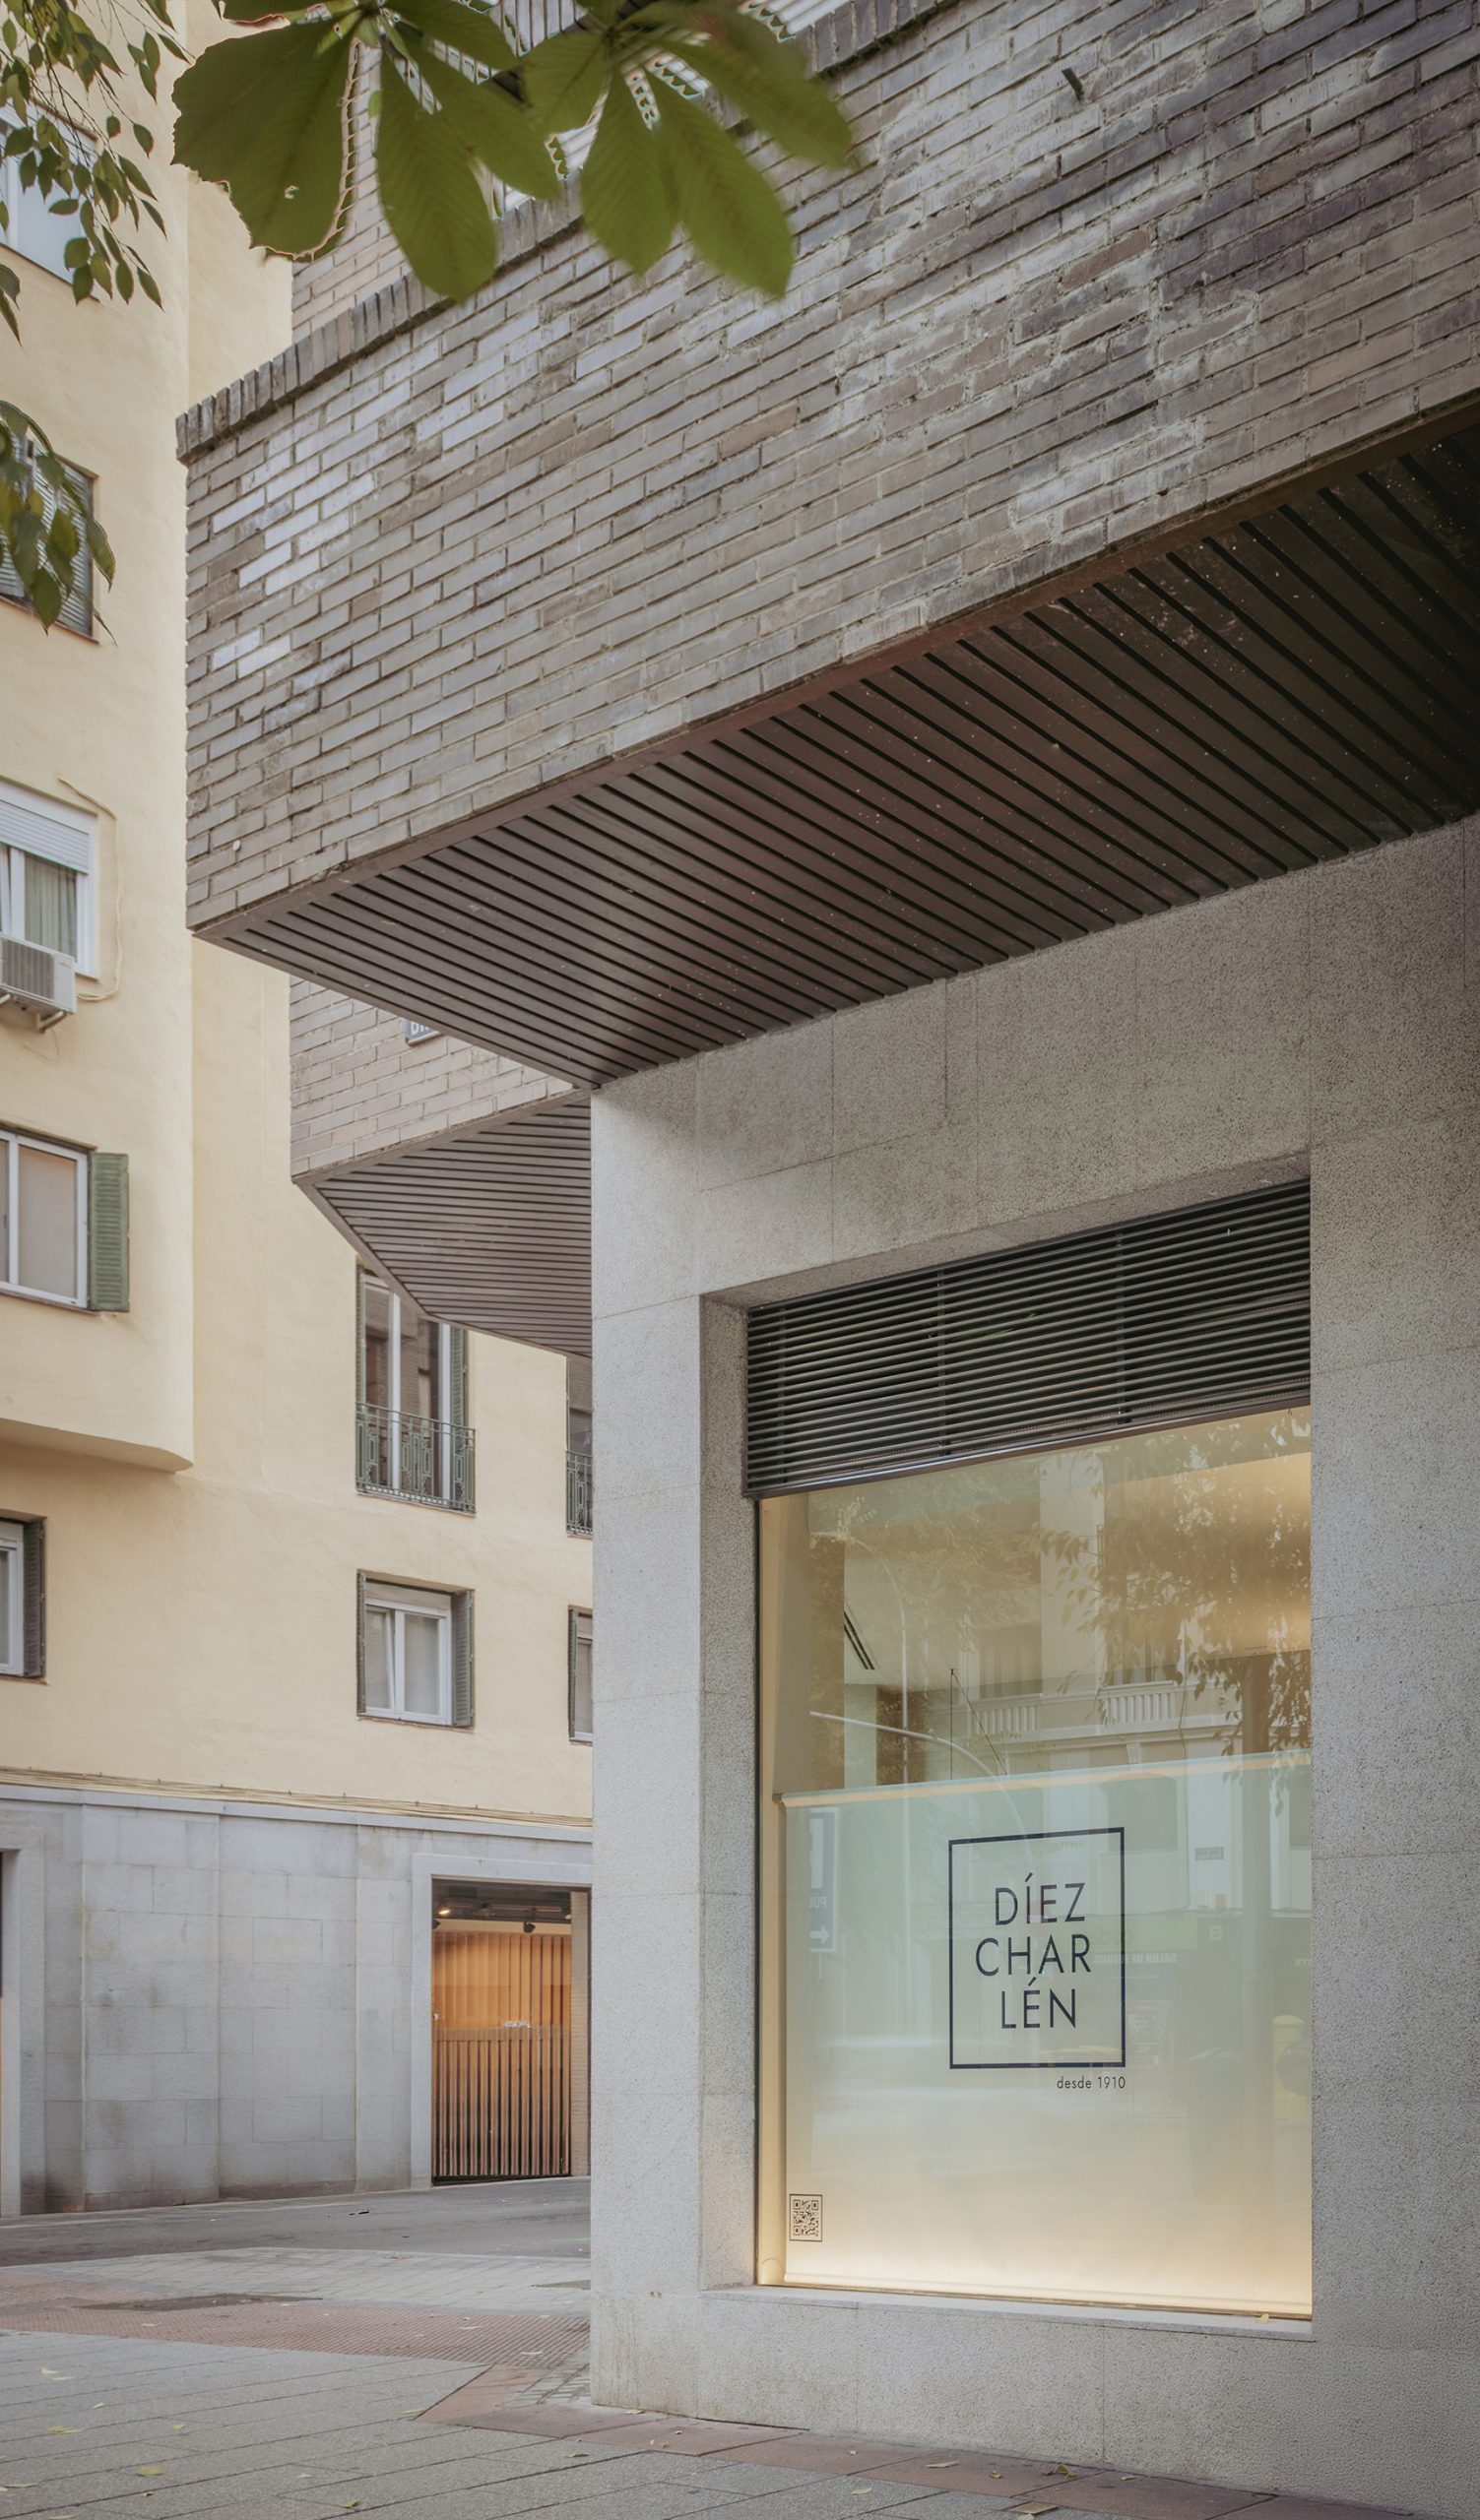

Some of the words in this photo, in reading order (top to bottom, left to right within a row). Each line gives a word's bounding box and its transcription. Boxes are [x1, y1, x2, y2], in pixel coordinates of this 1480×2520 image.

[995, 1871, 1086, 1926] DÍEZ
[975, 1933, 1092, 1977] CHAR
[1001, 1976, 1077, 2029] LÉN
[1057, 2075, 1092, 2089] desde
[1097, 2075, 1126, 2089] 1910
